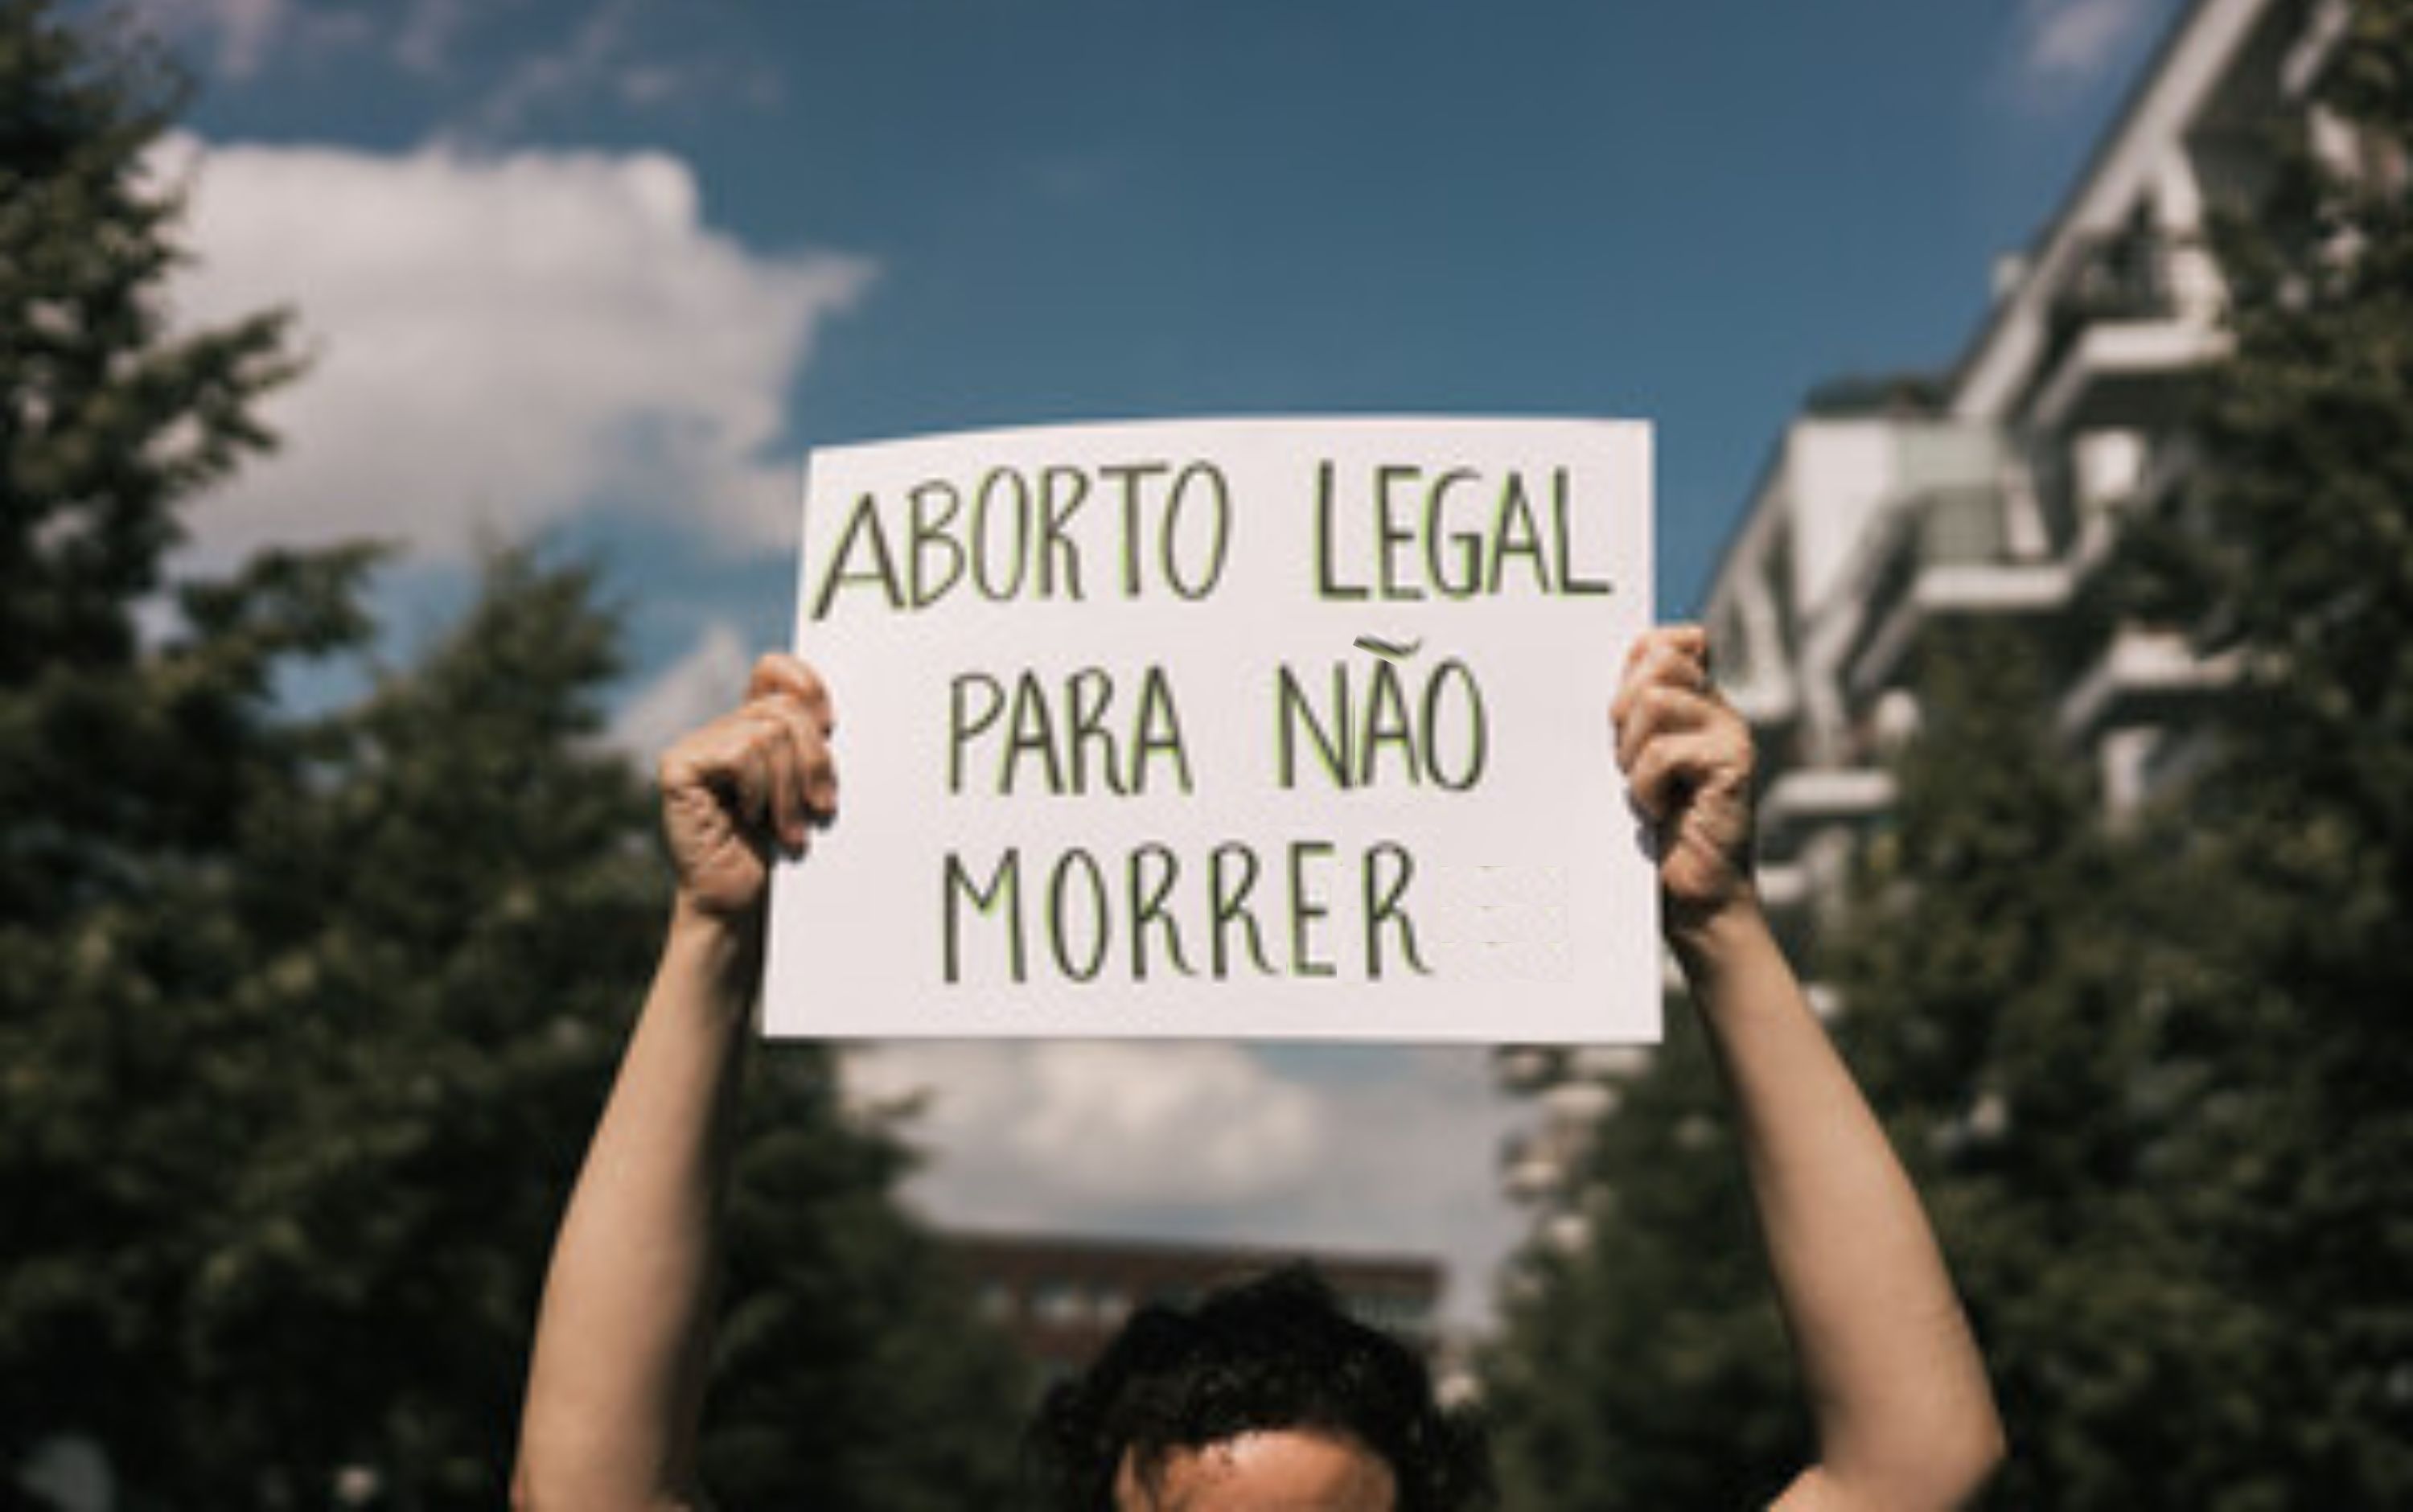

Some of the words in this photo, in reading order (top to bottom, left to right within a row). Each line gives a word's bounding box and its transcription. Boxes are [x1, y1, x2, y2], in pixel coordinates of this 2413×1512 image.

[811, 460, 1231, 622] ABORTO
[1314, 460, 1613, 602] LEGAL
[948, 665, 1194, 797] PARA
[1276, 637, 1487, 794] NÃO
[942, 840, 1434, 984] MORRER
